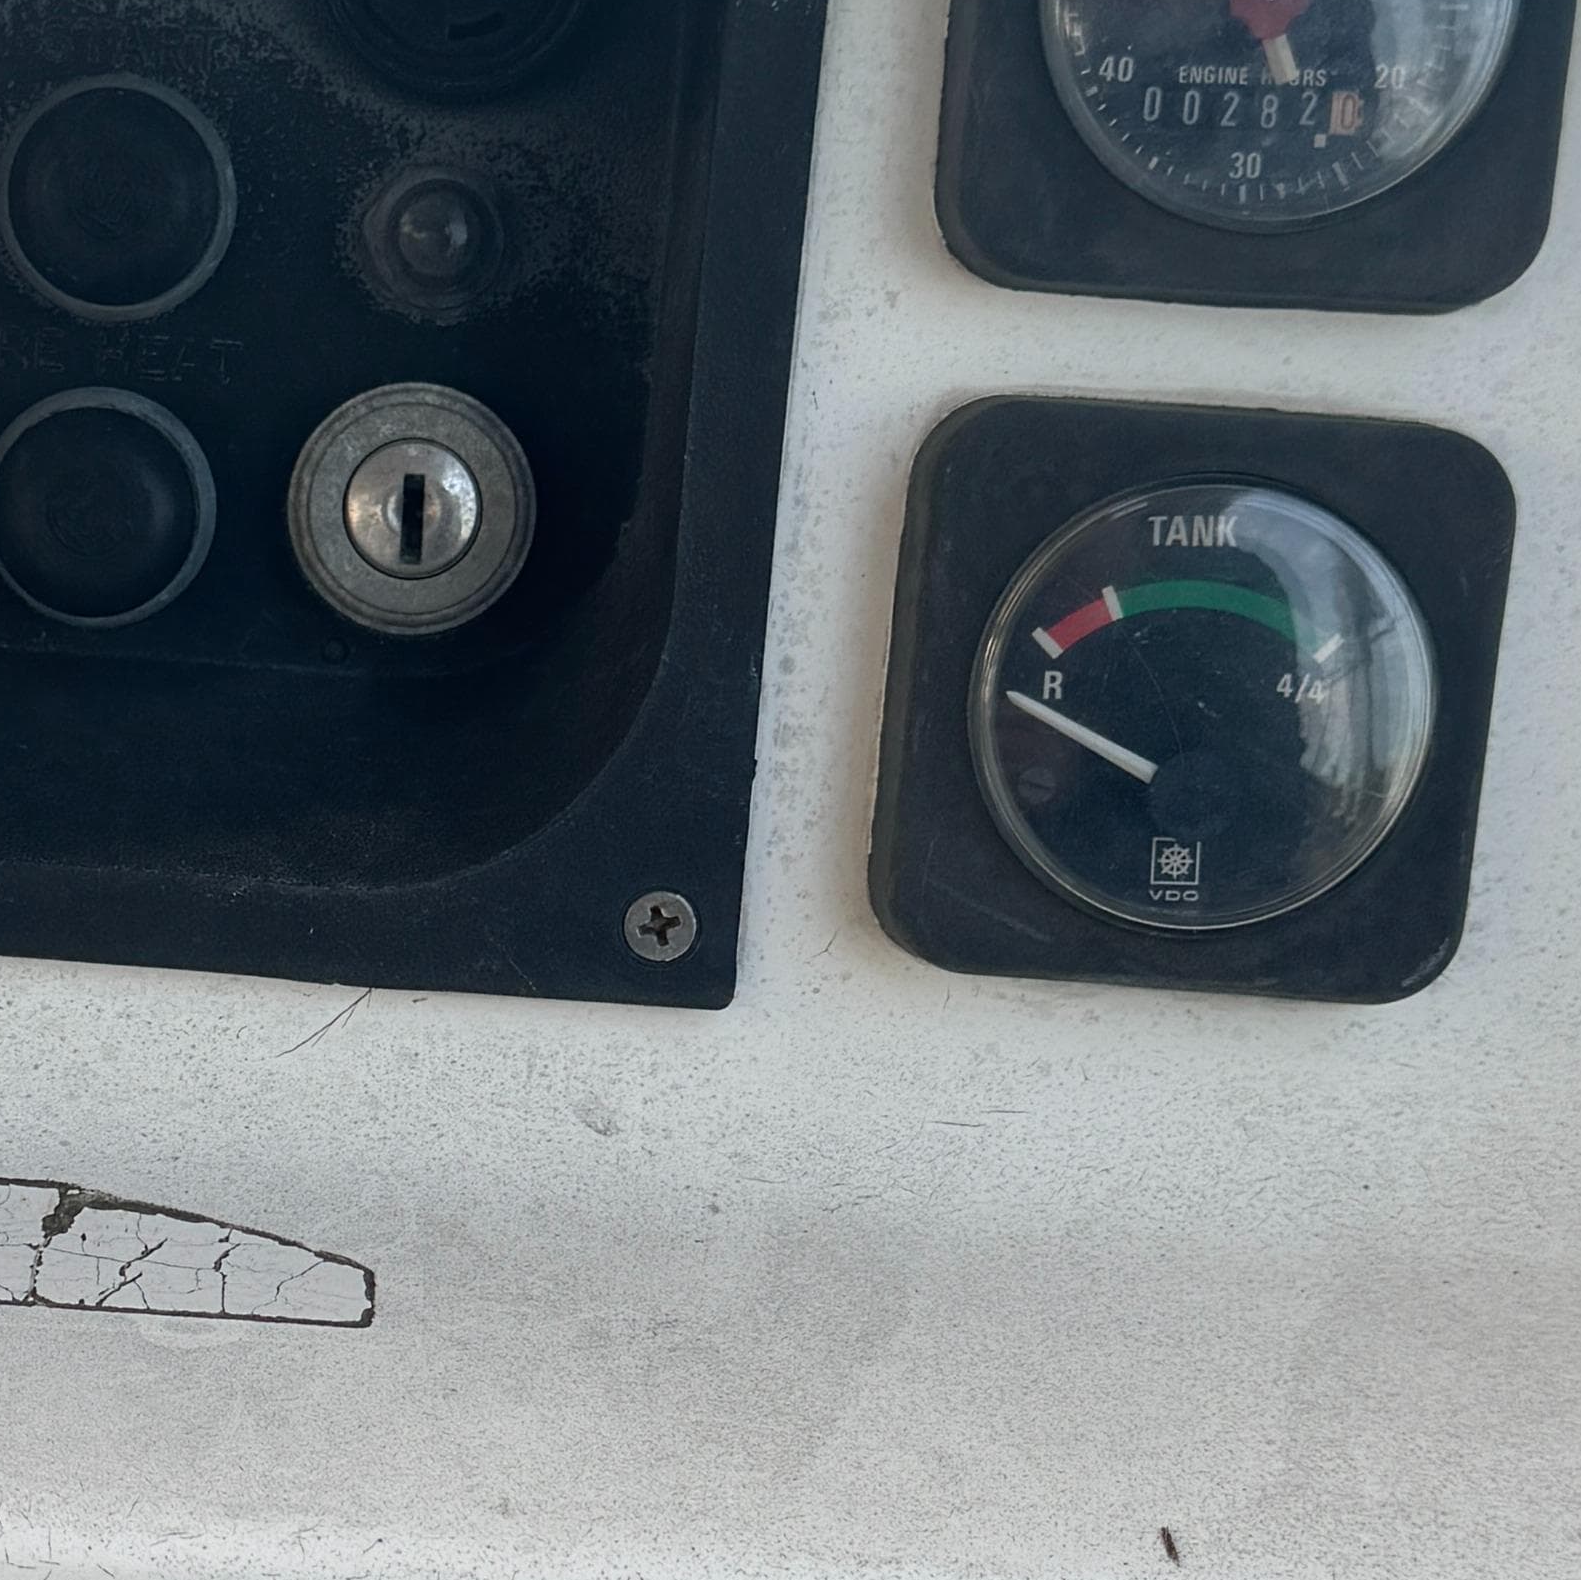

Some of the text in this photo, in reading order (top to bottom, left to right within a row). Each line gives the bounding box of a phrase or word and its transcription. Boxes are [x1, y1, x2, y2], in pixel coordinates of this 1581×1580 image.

[1100, 57, 1134, 83] 40
[1179, 65, 1249, 86] ENGINE
[1375, 66, 1405, 90] 20
[1230, 153, 1261, 180] 30
[1148, 516, 1238, 547] TANK
[1042, 671, 1063, 700] R
[1276, 673, 1325, 704] 4/4
[1148, 889, 1199, 902] VDO
